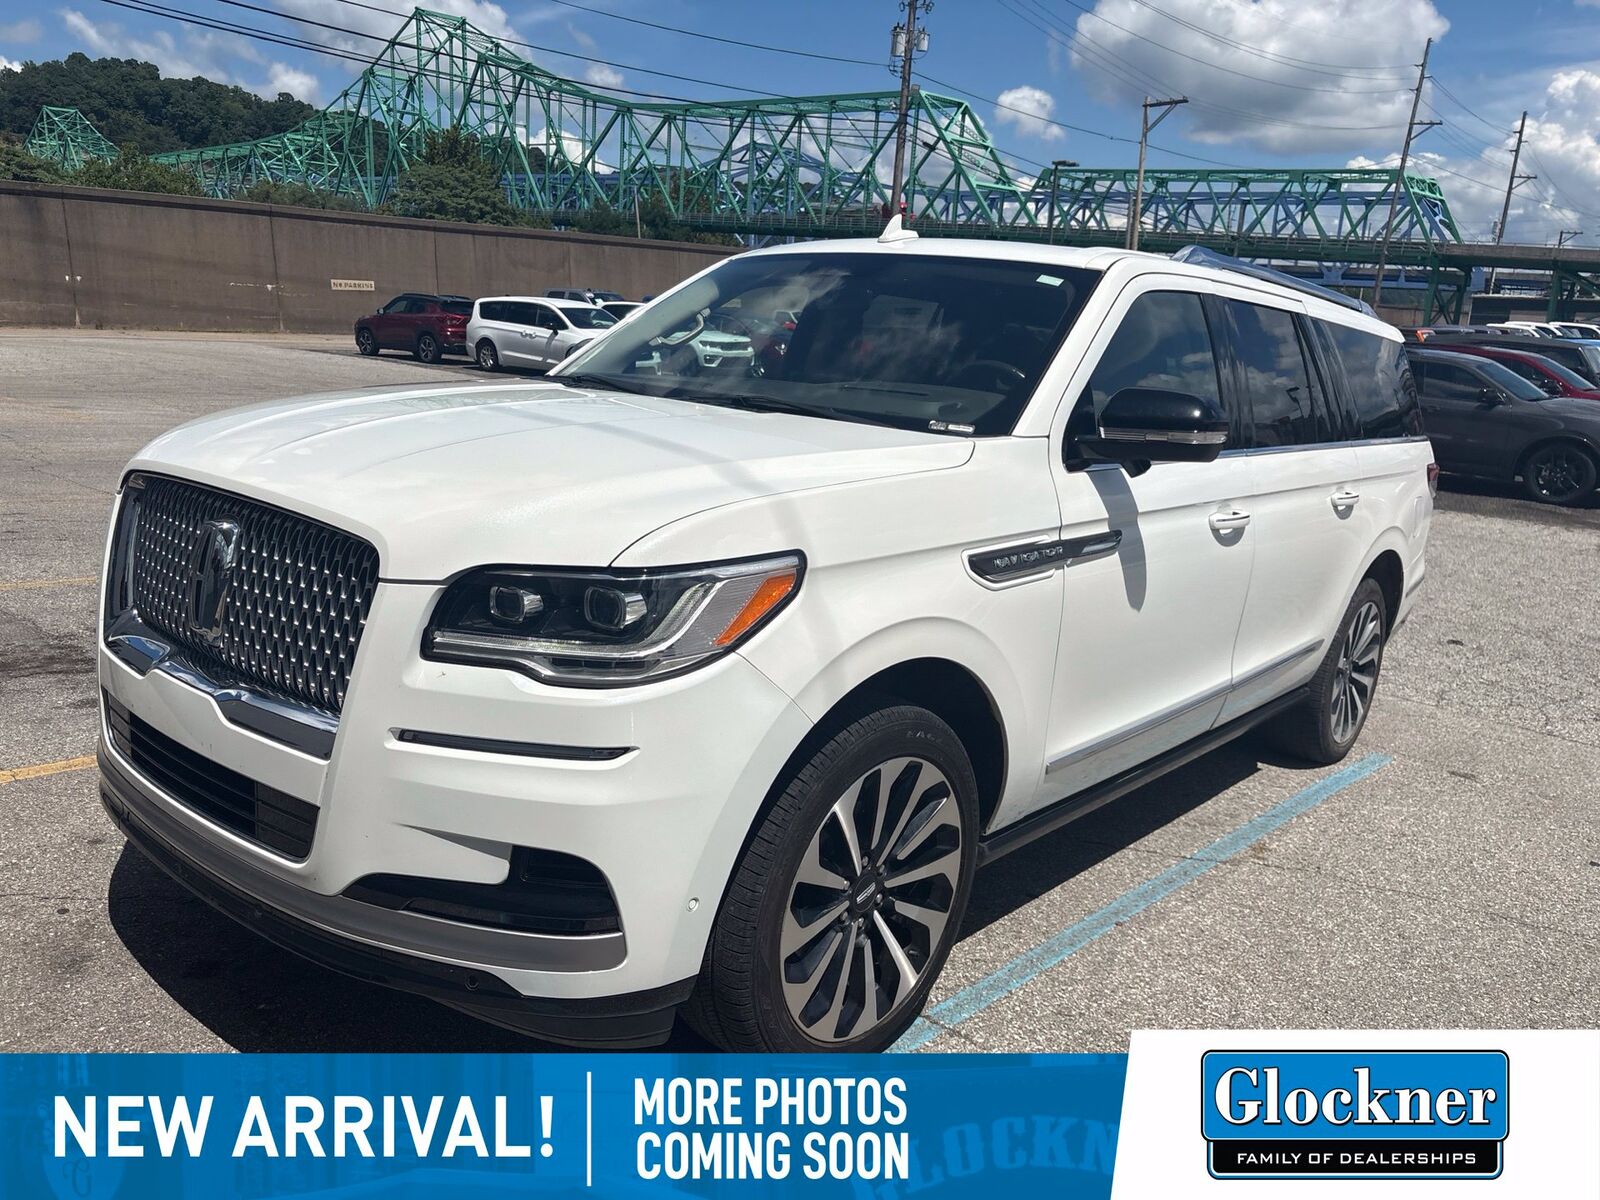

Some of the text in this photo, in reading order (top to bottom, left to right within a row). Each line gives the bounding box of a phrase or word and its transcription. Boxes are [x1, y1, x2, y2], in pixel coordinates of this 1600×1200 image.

[332, 281, 374, 289] NO PARKING
[994, 546, 1063, 567] NAVIGATOR
